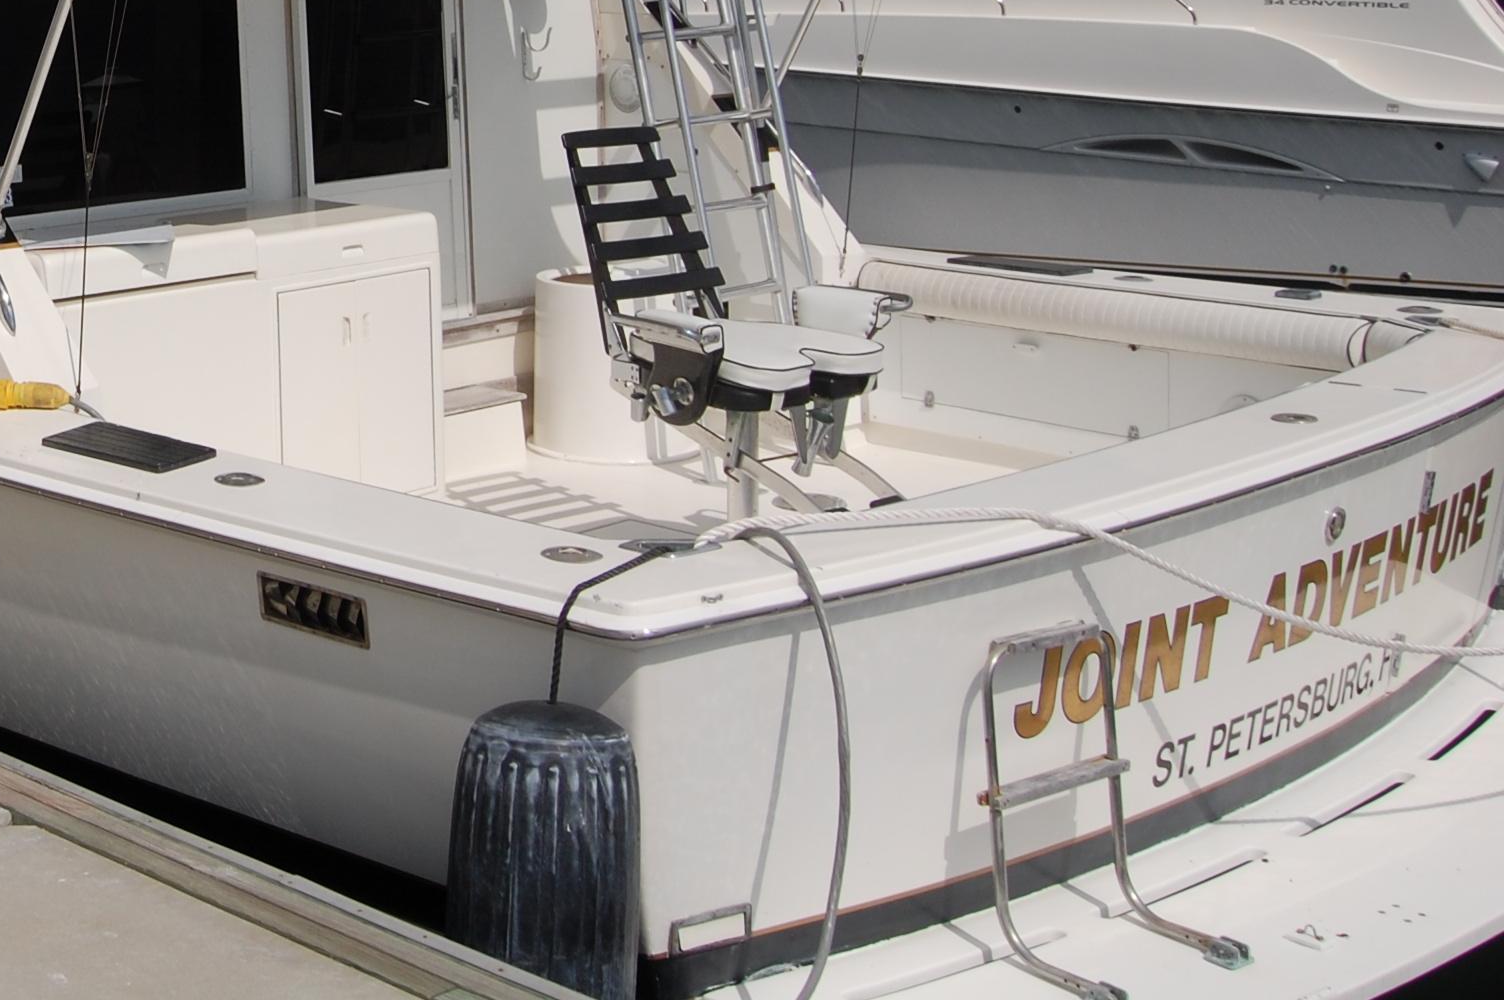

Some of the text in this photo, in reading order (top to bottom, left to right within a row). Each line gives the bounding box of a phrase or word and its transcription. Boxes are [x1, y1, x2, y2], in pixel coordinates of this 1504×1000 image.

[1013, 468, 1494, 739] JOINT ADVENTURE
[1152, 732, 1198, 788] ST.
